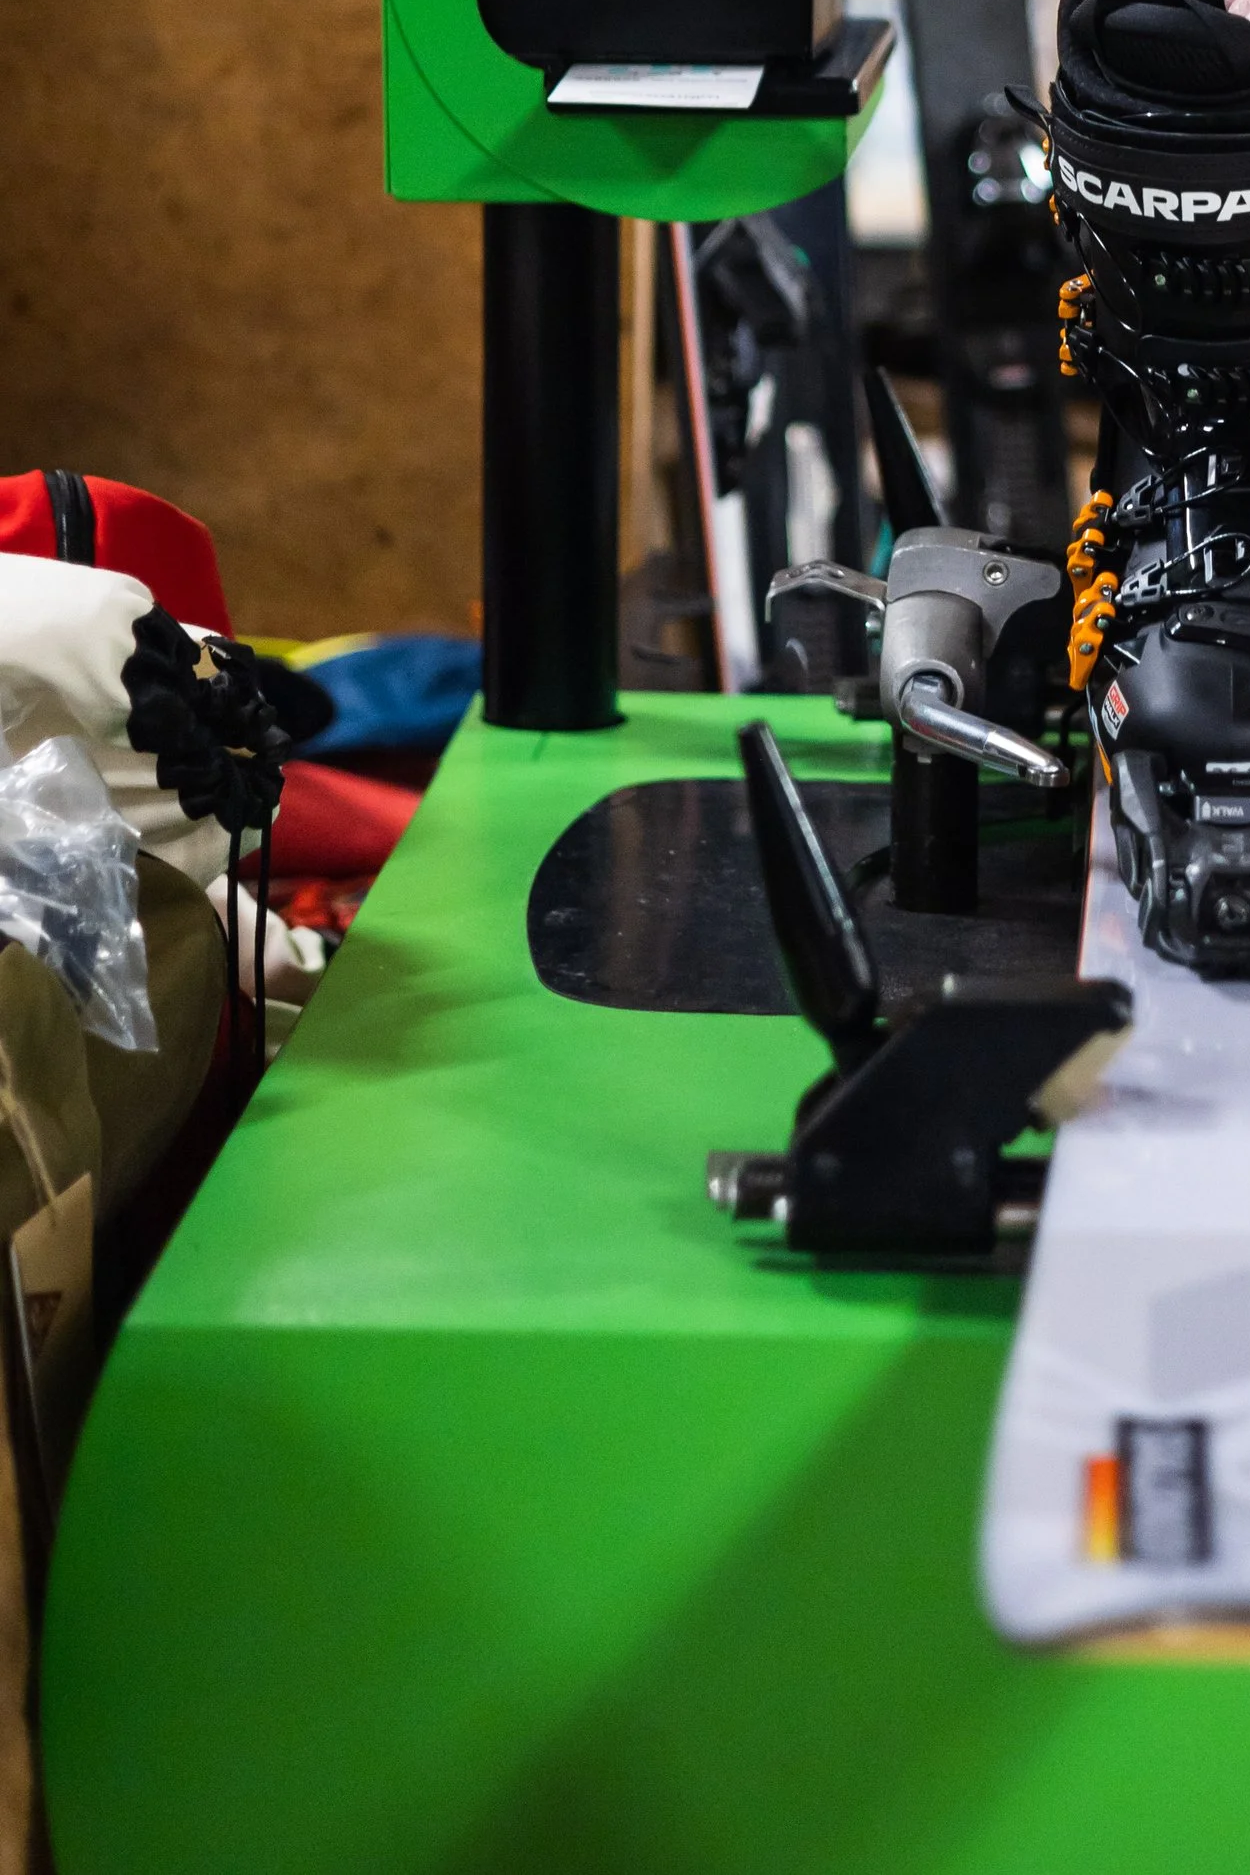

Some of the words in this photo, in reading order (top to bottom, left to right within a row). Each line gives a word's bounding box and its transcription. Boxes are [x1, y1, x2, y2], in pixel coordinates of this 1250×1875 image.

[1104, 699, 1121, 727] WALK
[1109, 685, 1127, 717] GRIP
[1212, 806, 1245, 817] WALK
